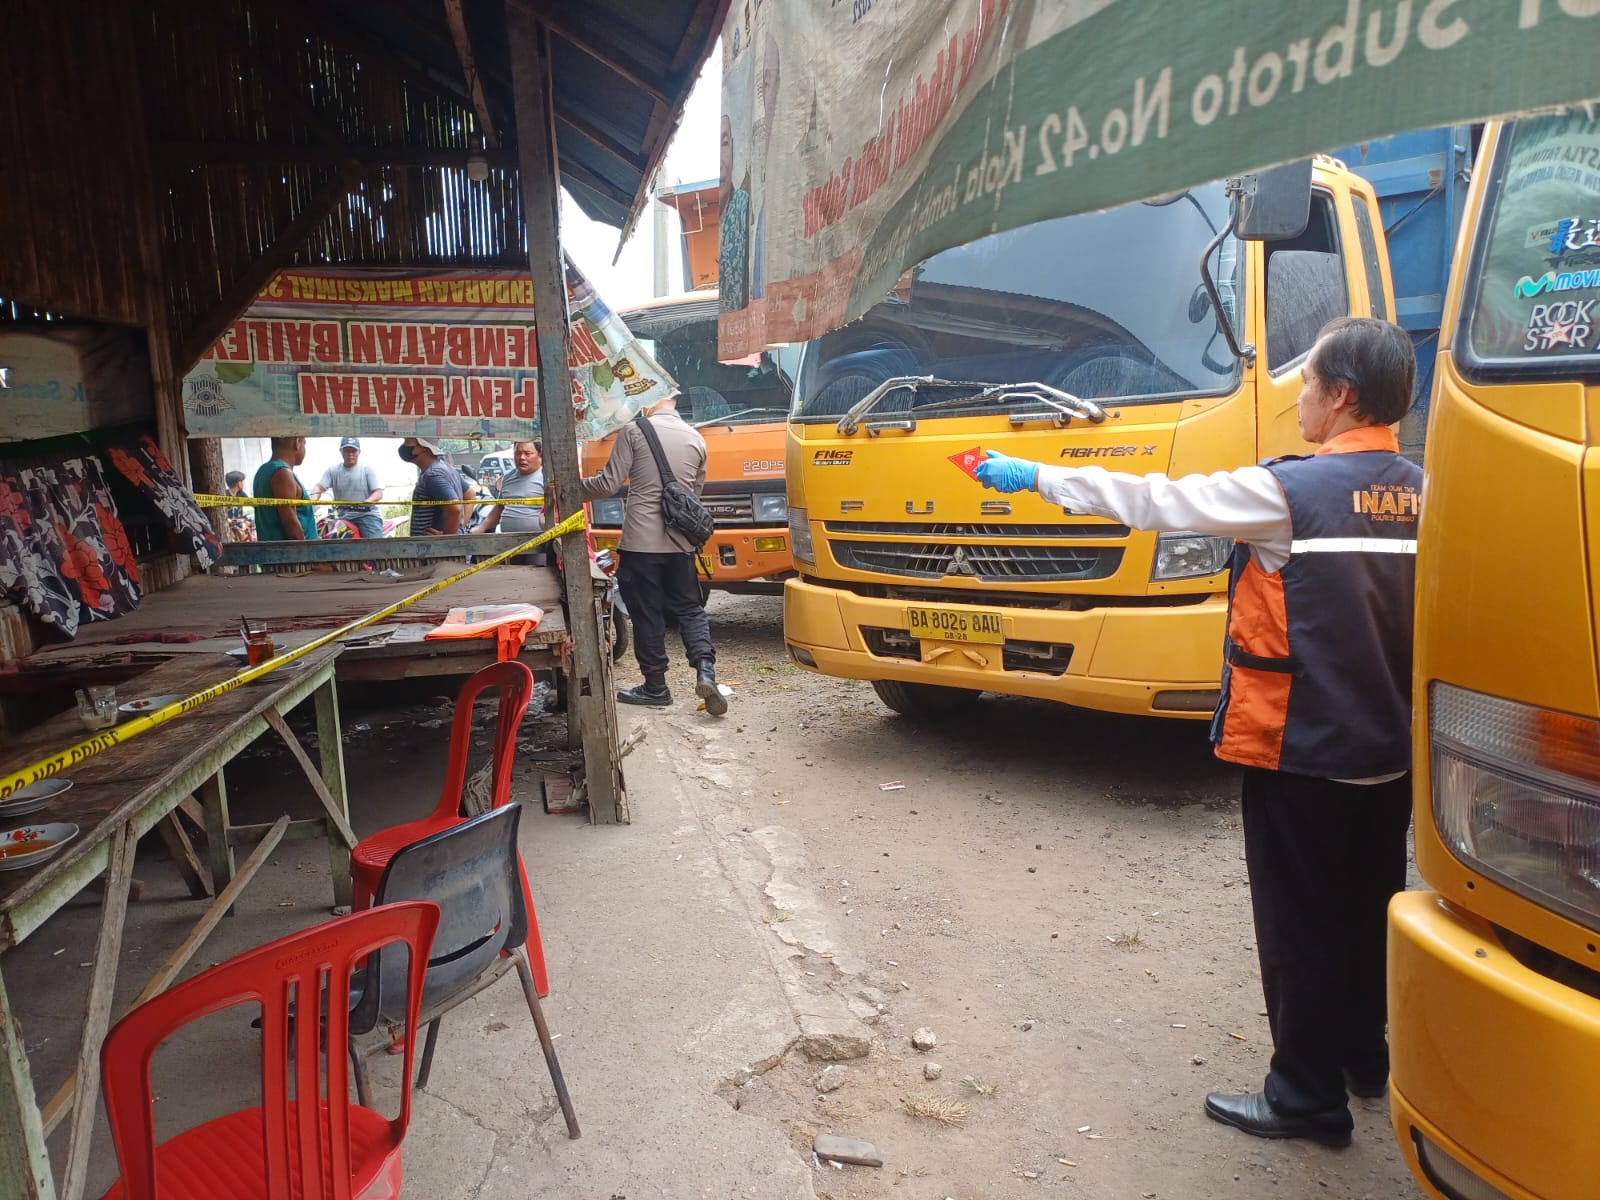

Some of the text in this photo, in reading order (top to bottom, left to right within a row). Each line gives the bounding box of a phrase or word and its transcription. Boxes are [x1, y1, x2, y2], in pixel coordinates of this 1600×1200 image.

[286, 275, 413, 302] MAKSIMAL
[418, 279, 535, 305] ENDARAAN
[1528, 299, 1596, 328] ROCK
[350, 323, 538, 368] JEMBATAN
[299, 374, 536, 419] PENYEKATAN
[814, 450, 854, 459] FN62
[1060, 445, 1158, 458] FIGHTER X
[743, 460, 785, 471] 220PS
[910, 609, 929, 629] BA
[932, 611, 967, 631] 8026
